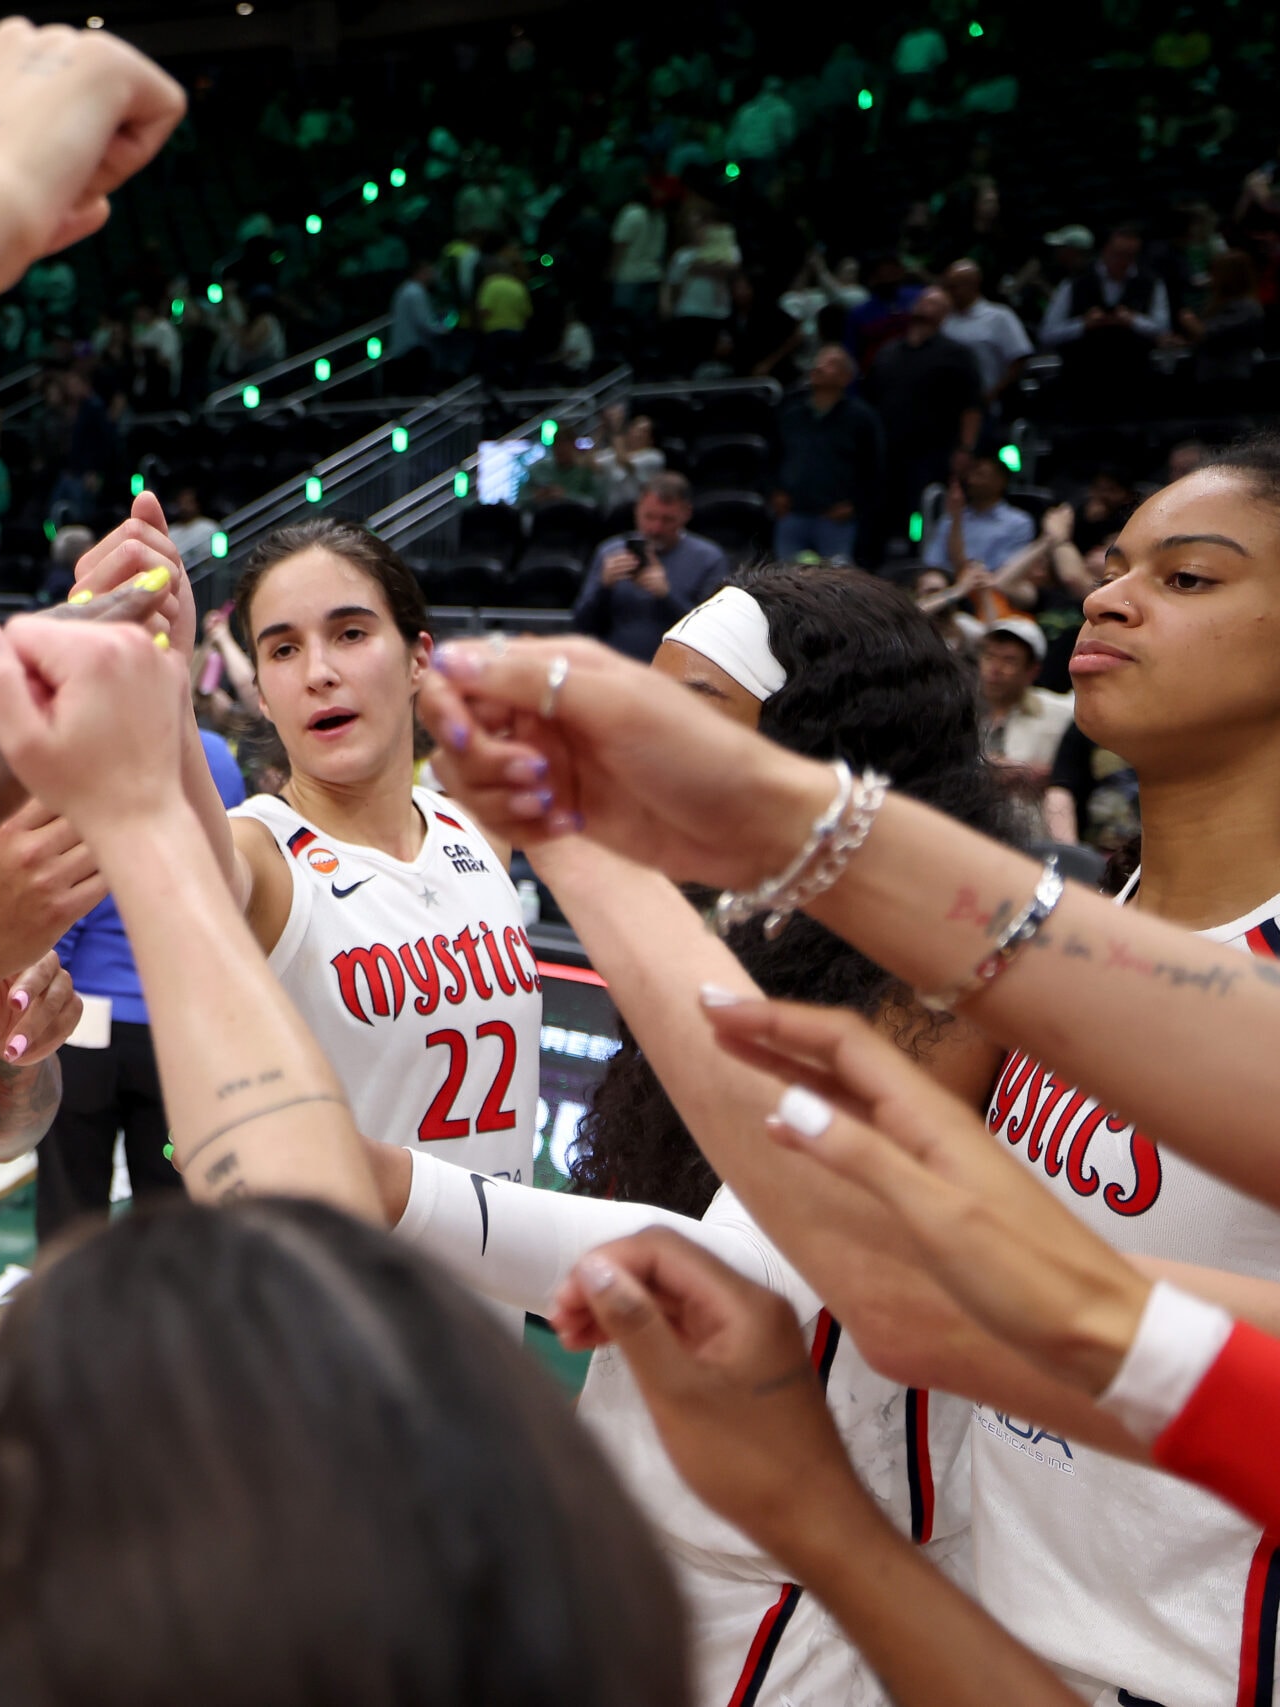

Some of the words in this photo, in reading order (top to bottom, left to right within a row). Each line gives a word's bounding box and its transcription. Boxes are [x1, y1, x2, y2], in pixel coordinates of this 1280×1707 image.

[452, 858, 490, 874] max
[418, 1020, 517, 1142] 22
[988, 1050, 1162, 1217] ystics
